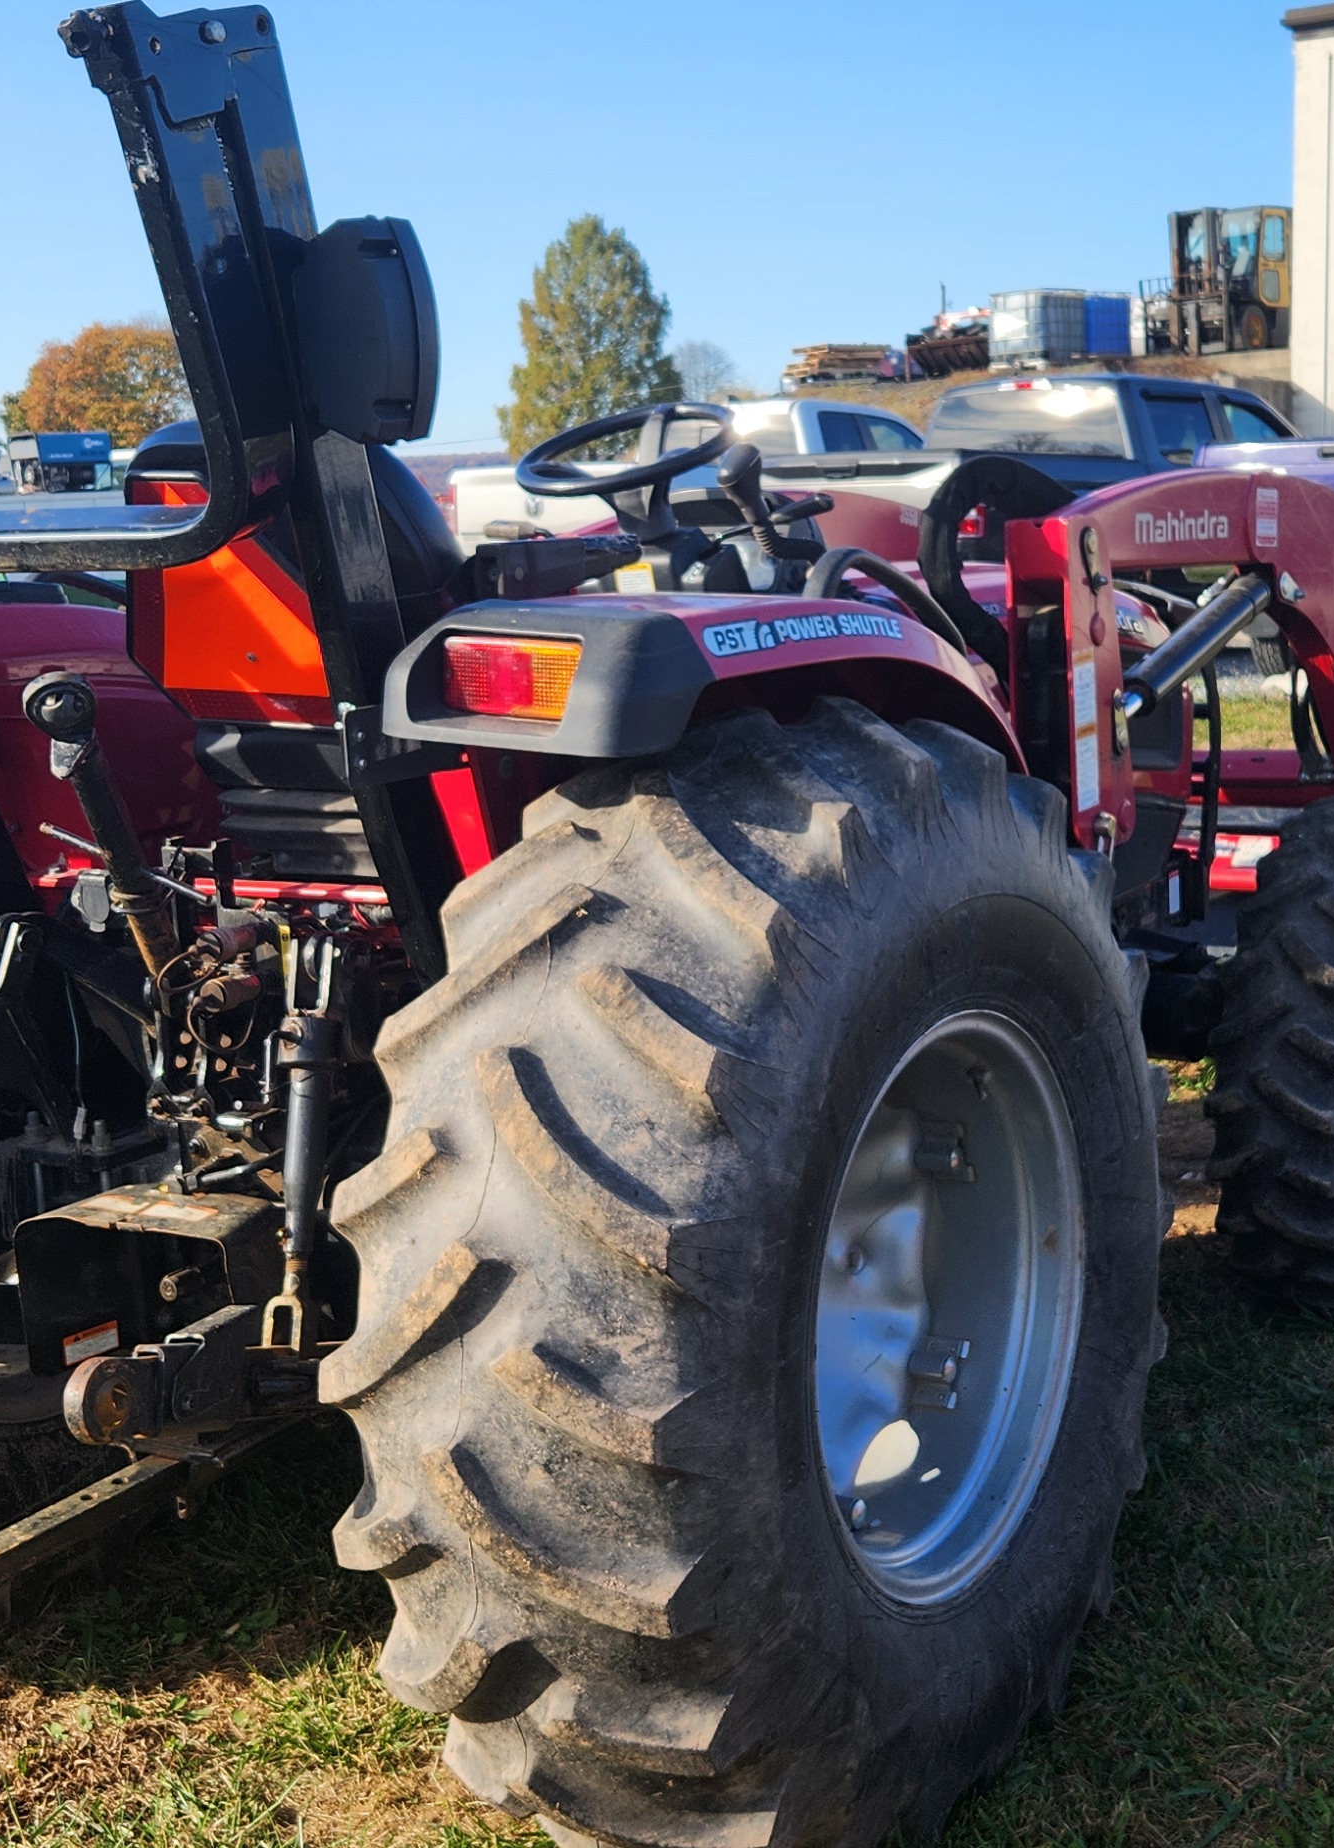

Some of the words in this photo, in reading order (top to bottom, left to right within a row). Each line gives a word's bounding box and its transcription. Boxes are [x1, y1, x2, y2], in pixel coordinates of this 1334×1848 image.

[1135, 509, 1229, 545] Mahindra
[713, 626, 748, 652] PST
[772, 614, 839, 644] POWER
[837, 613, 903, 640] SHUTTLE
